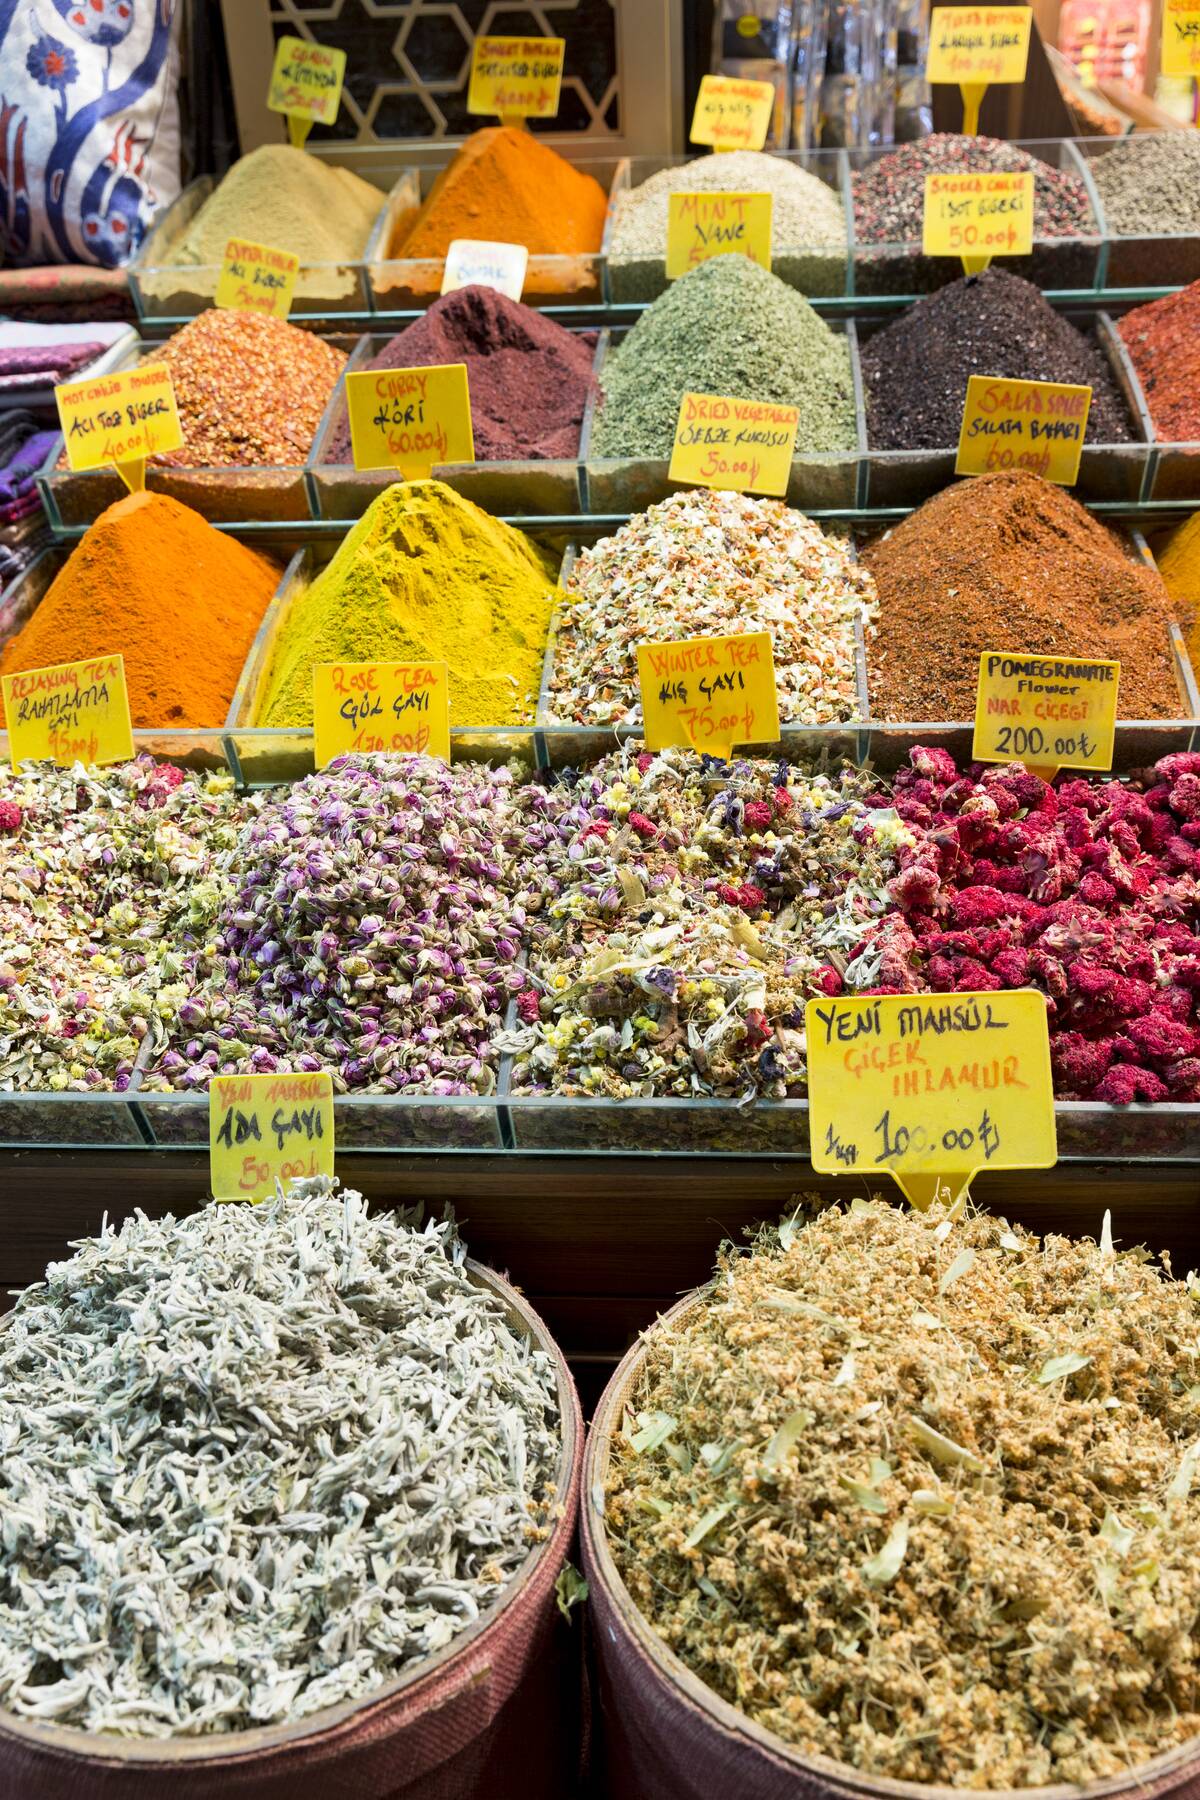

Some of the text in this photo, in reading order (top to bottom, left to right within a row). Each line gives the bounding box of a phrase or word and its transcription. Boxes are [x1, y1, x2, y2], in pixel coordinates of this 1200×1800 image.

[679, 195, 752, 223] MINT
[375, 374, 428, 400] CURRY
[977, 384, 1044, 414] SALAD
[685, 397, 730, 421] DRIED
[967, 417, 1023, 438] SALATA
[647, 640, 761, 678] WINTER TEA
[987, 655, 1115, 683] POMEGRANATE
[10, 660, 118, 702] RELAXING TEA
[331, 666, 439, 697] ROSE TEA
[698, 670, 745, 703] ÇAYI
[1017, 680, 1081, 696] Flower
[392, 690, 430, 721] ÇAYI
[986, 697, 1022, 716] NAR
[815, 1000, 882, 1045] YENİ
[843, 1039, 927, 1079] ÇİÇEK
[892, 1054, 1031, 1097] IHLAMUR
[216, 1104, 324, 1152] ADA ÇAYI
